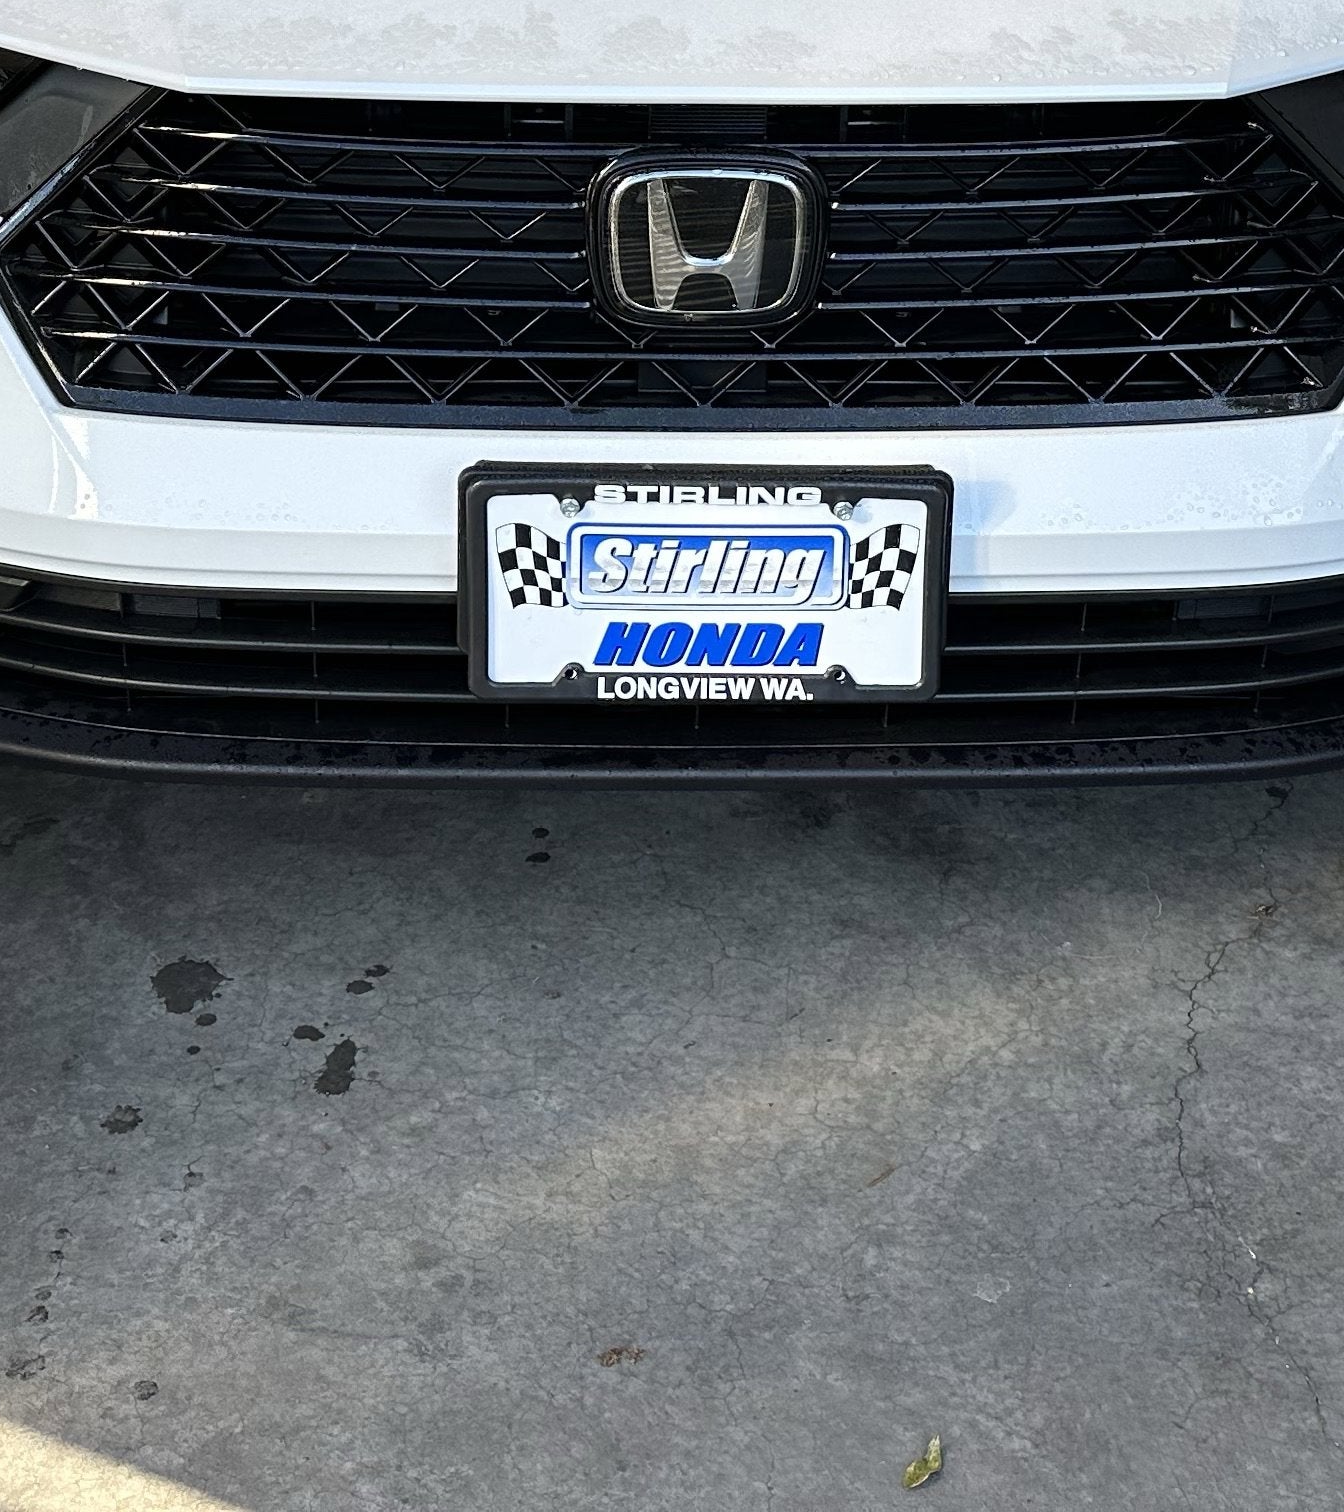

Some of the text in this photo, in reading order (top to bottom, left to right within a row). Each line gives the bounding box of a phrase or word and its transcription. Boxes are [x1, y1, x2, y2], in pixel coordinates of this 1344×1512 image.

[594, 484, 822, 507] STIRLING
[588, 537, 827, 606] Stirling
[592, 621, 824, 667] HONDA
[597, 676, 814, 701] LONGVIEW WA.
